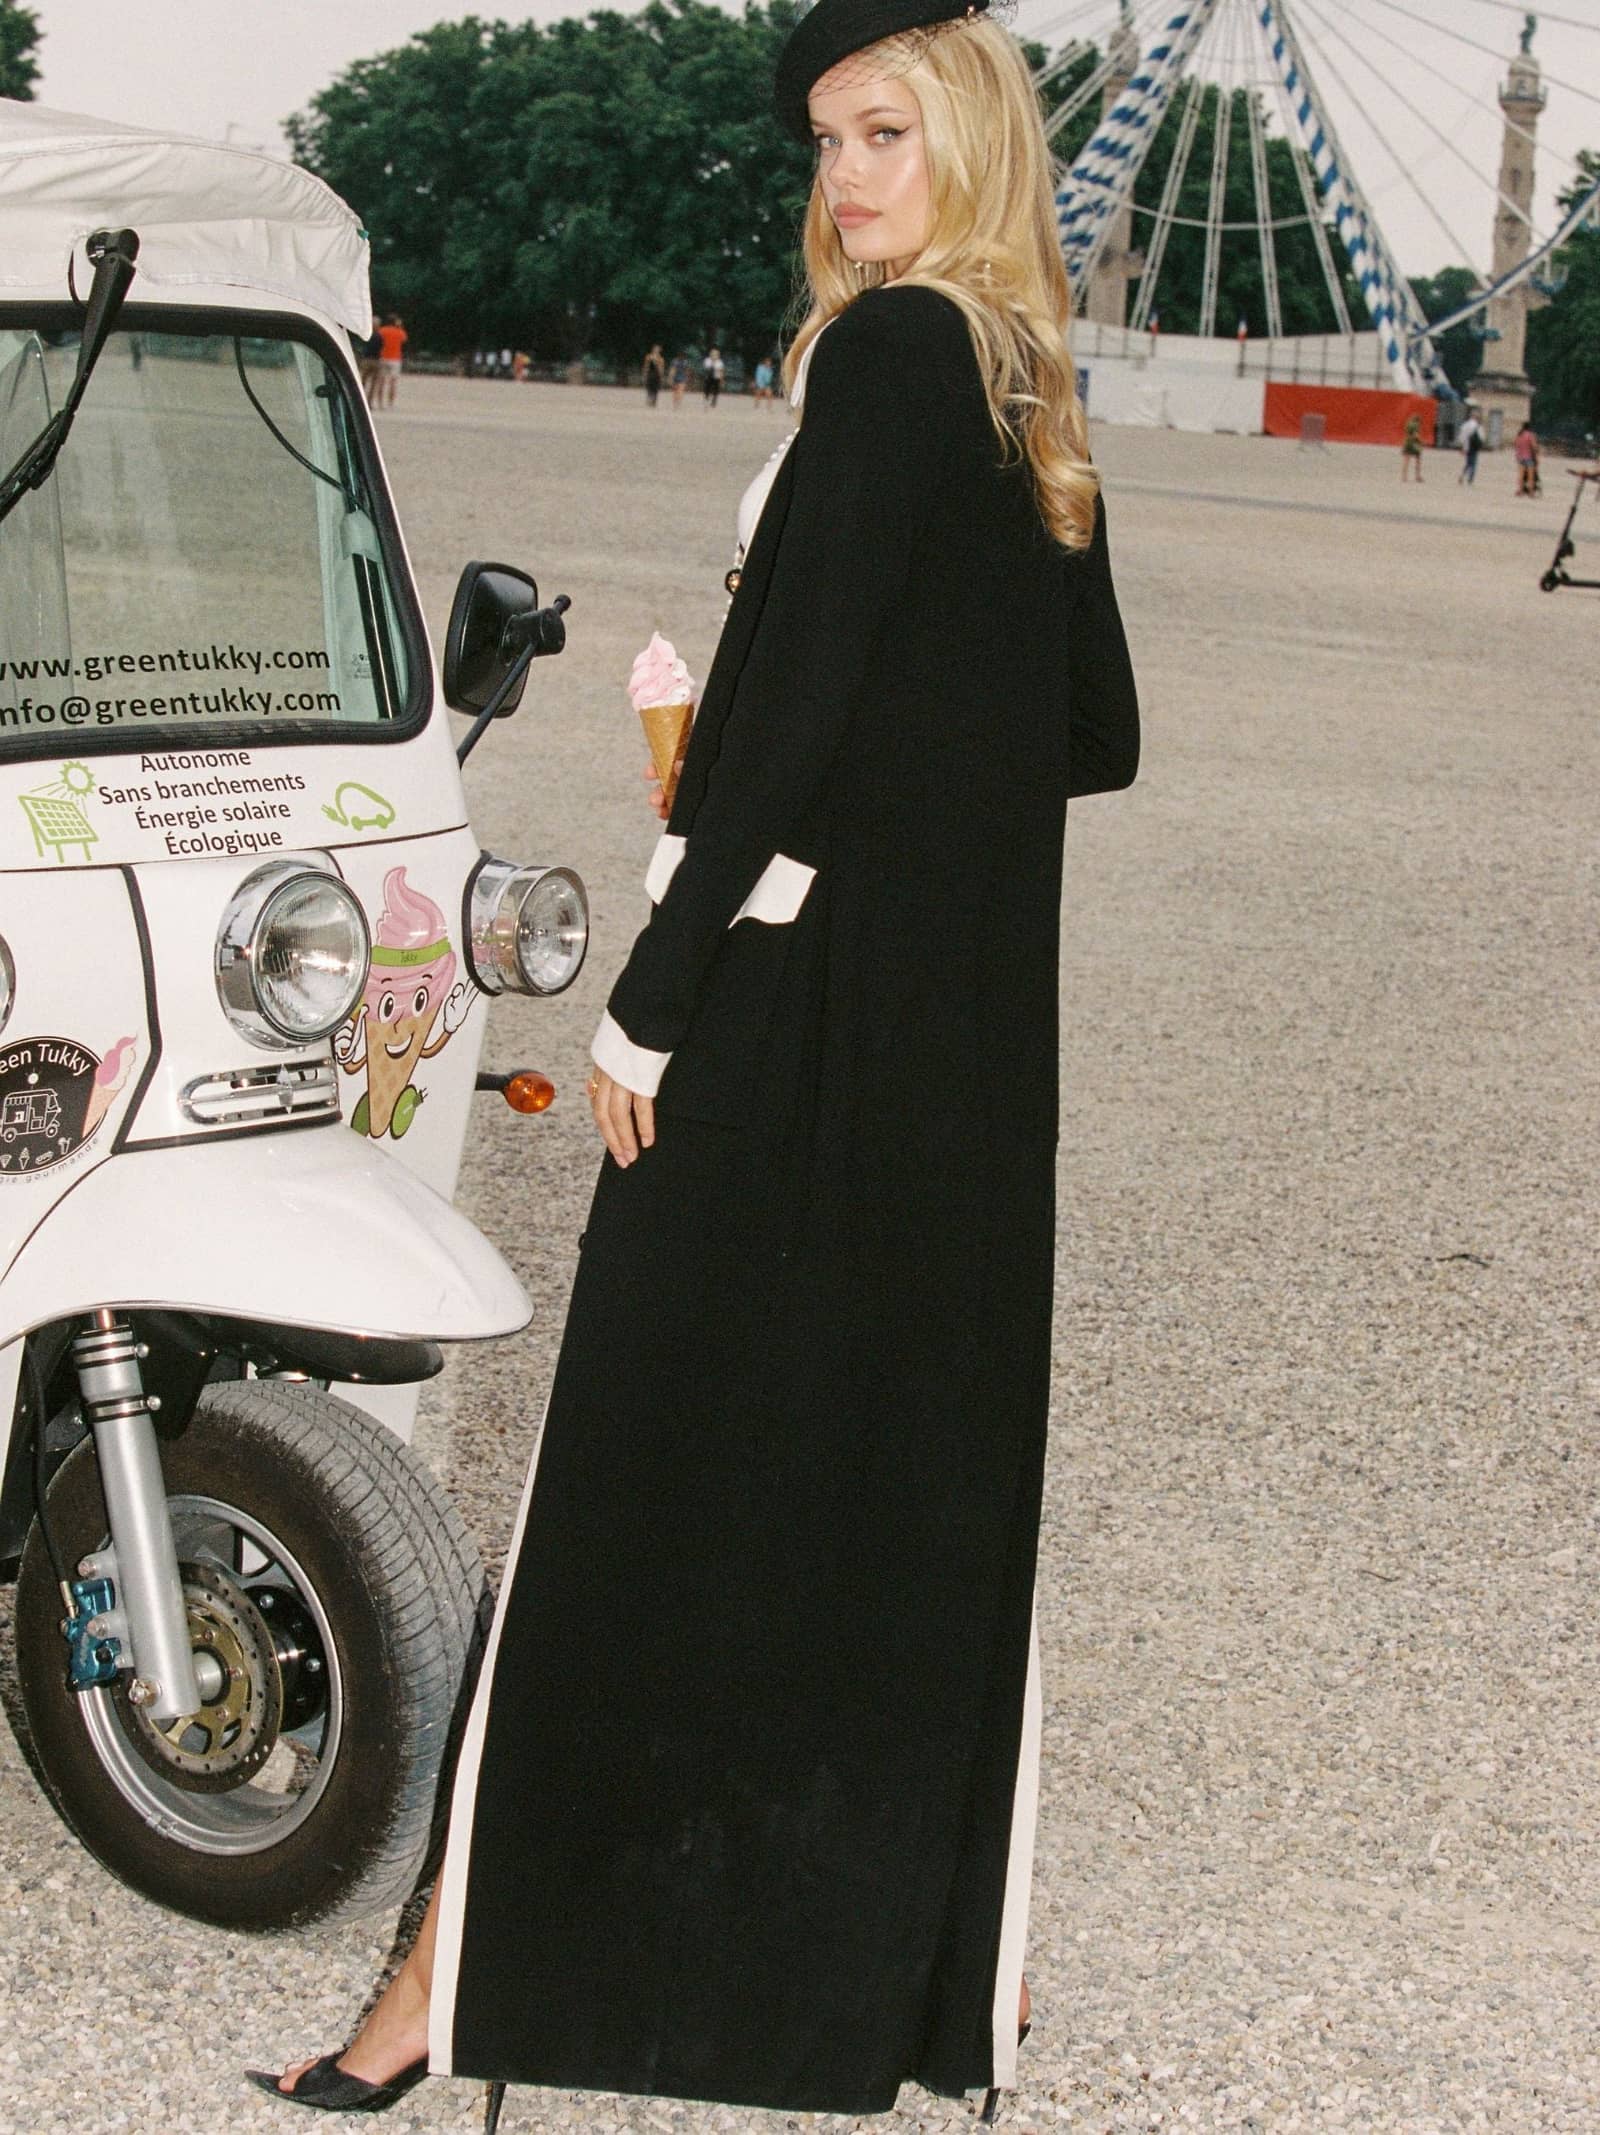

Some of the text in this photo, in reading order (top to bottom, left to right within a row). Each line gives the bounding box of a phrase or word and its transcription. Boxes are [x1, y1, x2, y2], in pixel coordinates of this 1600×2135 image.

[0, 645, 331, 681] ww.greentukky.com
[141, 751, 252, 773] Autonome
[98, 773, 306, 805] Sans branchements
[135, 800, 291, 830] Énergie solaire
[164, 829, 283, 855] Écologique
[37, 1043, 91, 1077] Tukky
